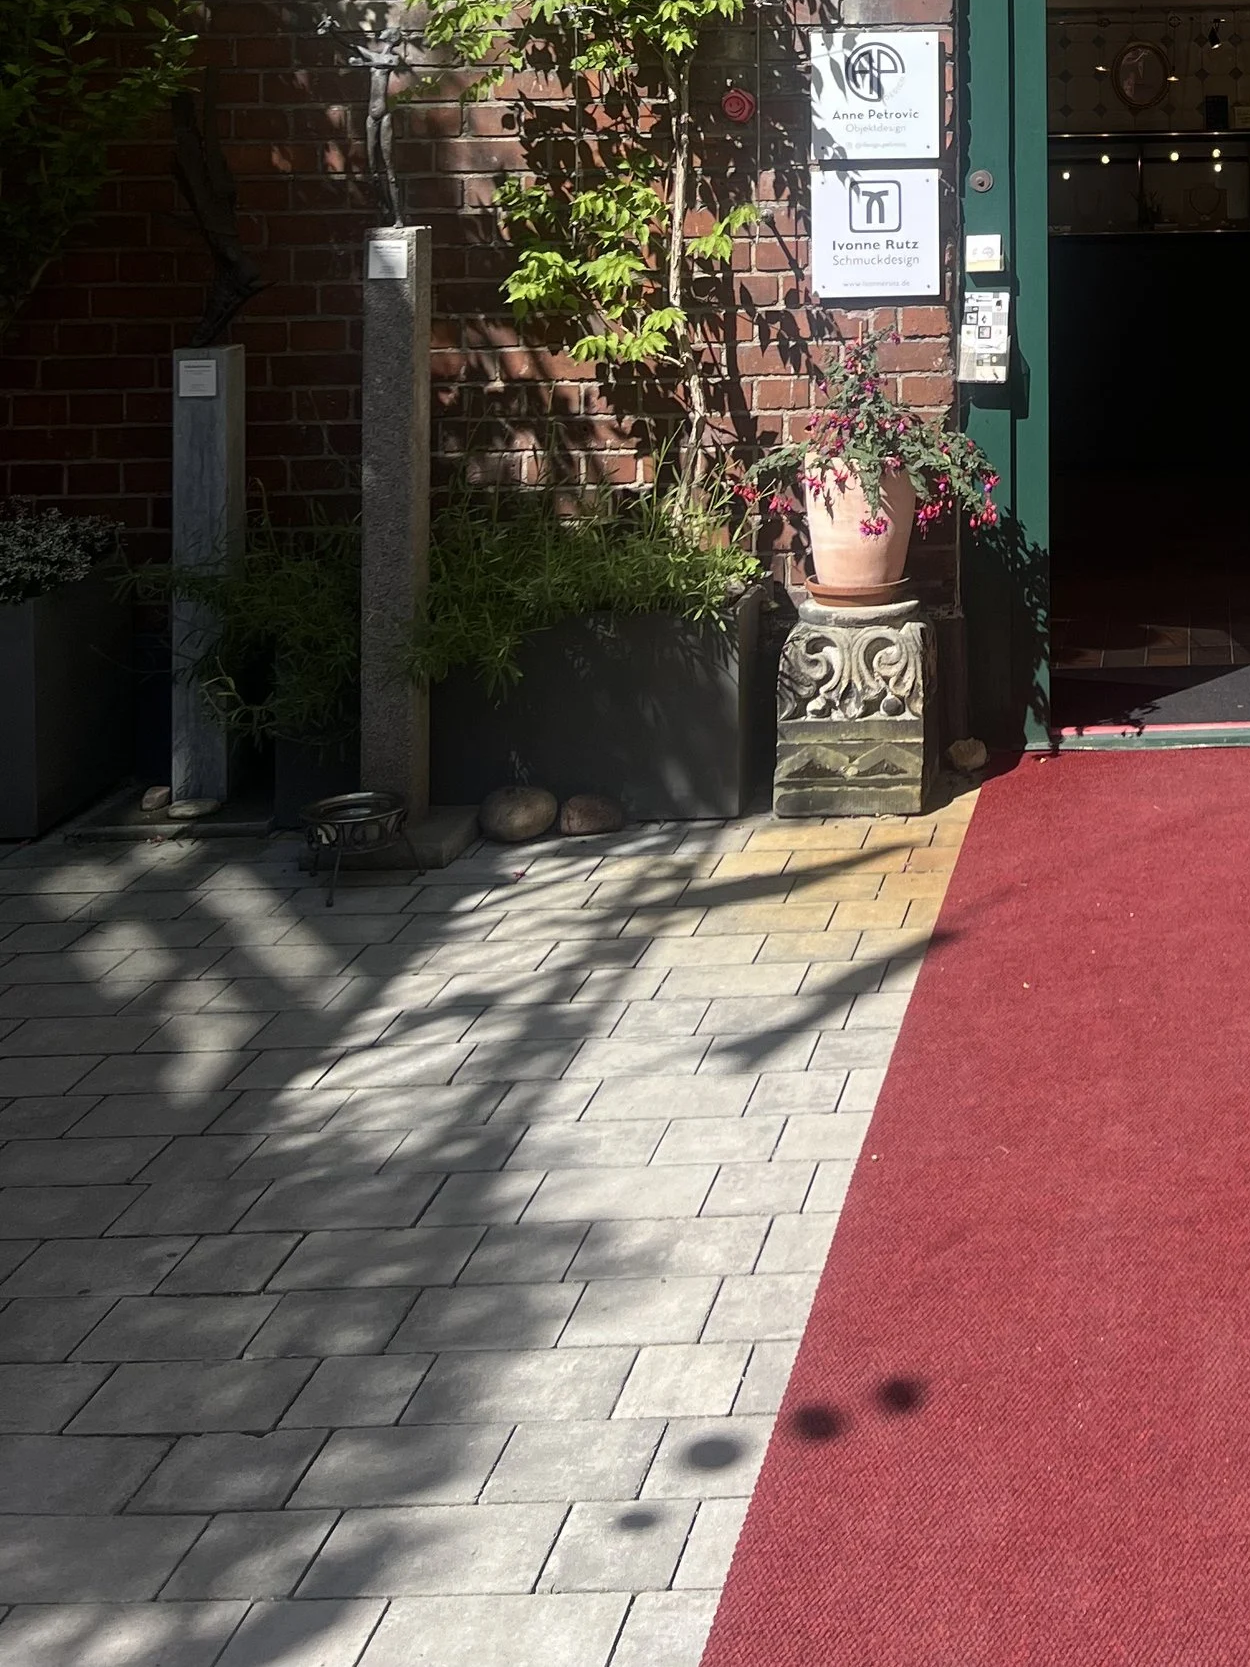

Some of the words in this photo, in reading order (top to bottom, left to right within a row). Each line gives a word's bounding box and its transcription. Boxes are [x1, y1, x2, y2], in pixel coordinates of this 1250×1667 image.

[832, 111, 865, 120] Anne
[868, 109, 920, 120] Petrovic
[845, 123, 906, 134] Objektdesign
[832, 240, 881, 251] Ivonne
[885, 239, 919, 250] Rutz
[832, 254, 919, 267] Schmuckdesign
